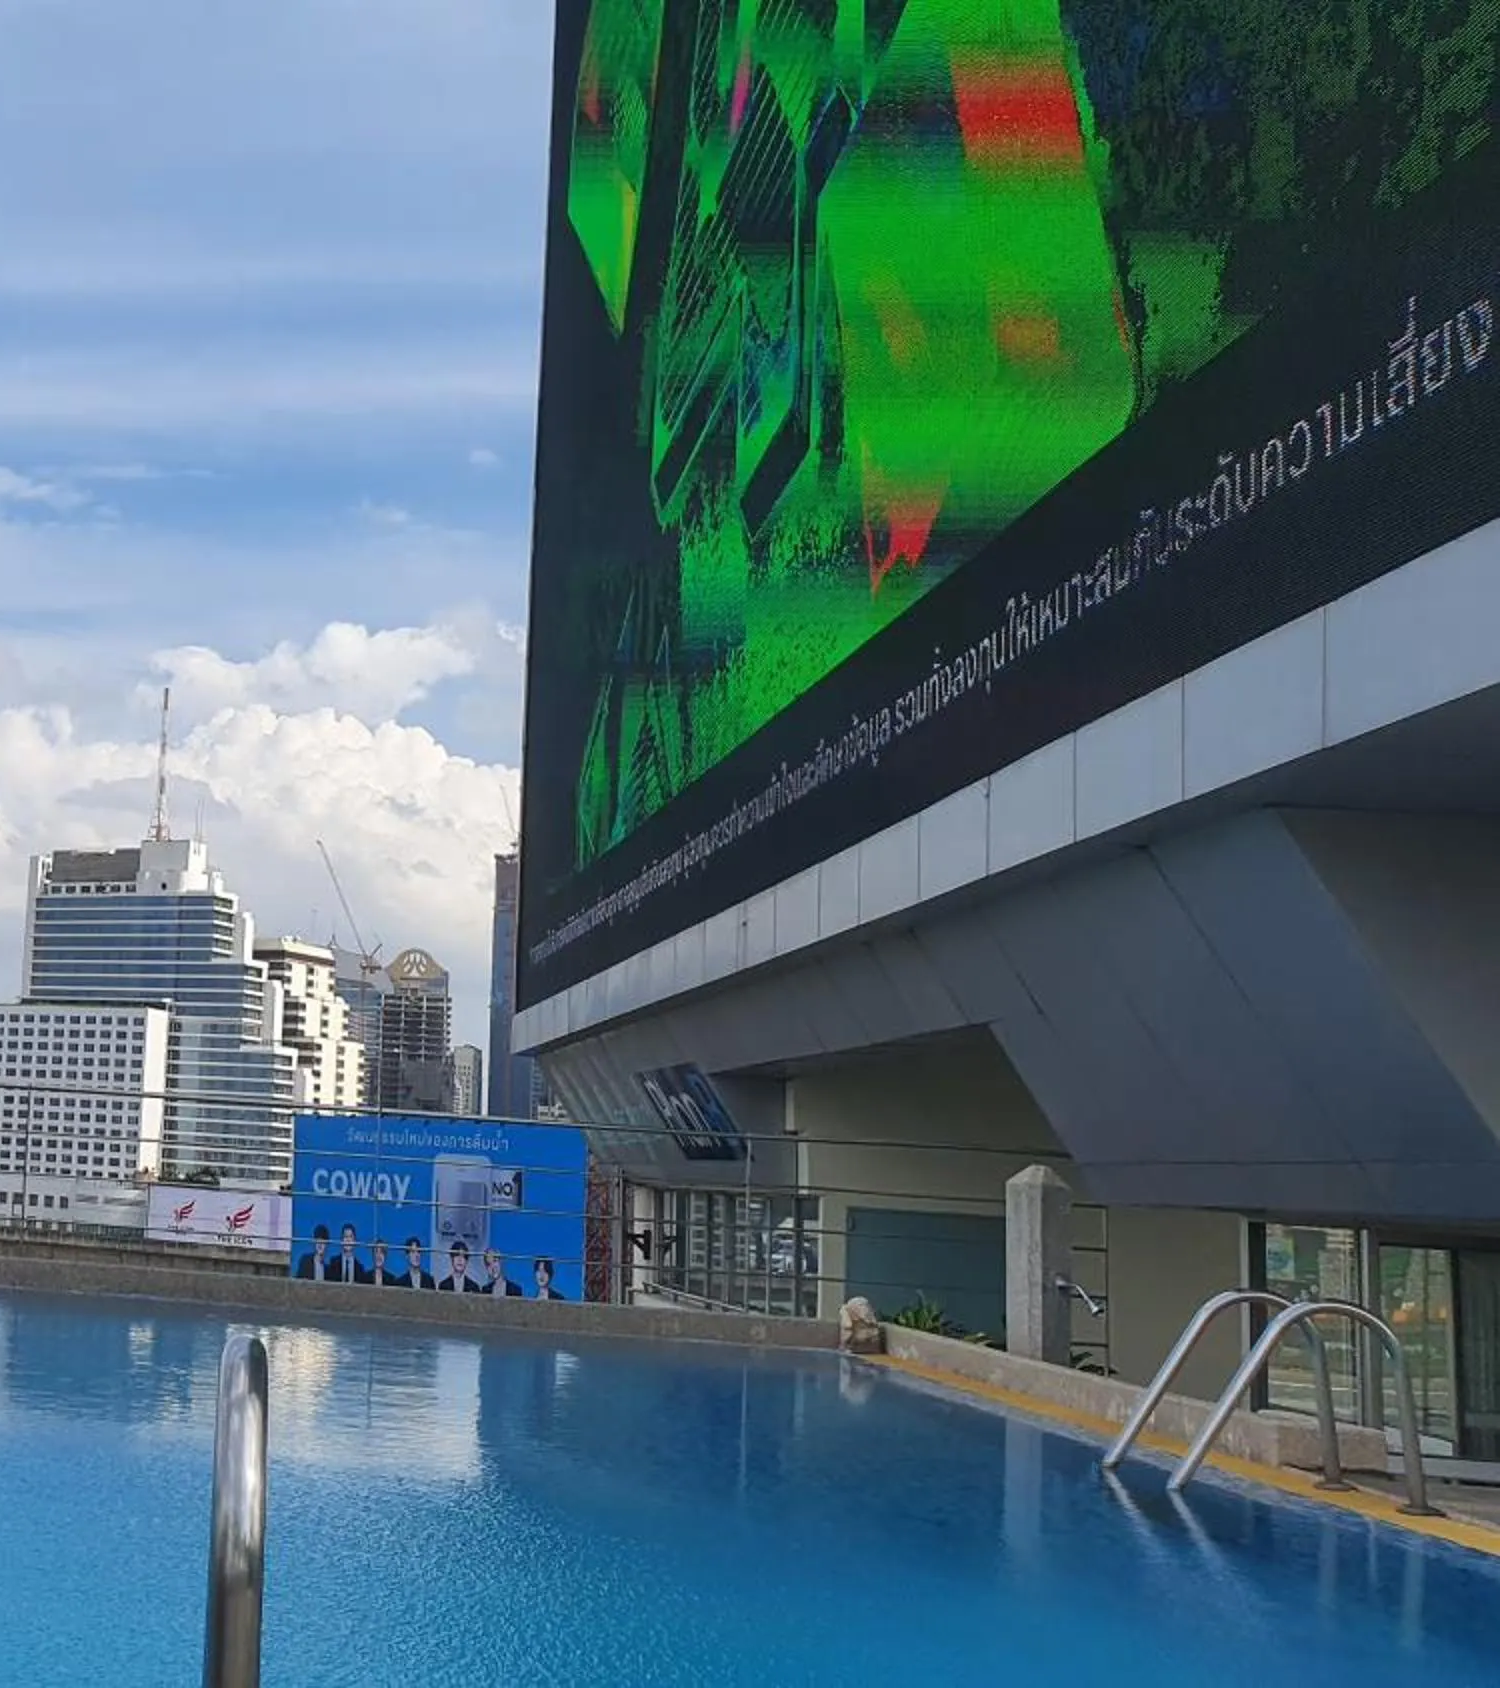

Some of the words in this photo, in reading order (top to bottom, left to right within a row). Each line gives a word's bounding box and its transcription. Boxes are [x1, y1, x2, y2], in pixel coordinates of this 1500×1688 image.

[894, 296, 1494, 735] รวมทั้งลงทุนให้เหมาะสมกับระดับความเสี่ยง
